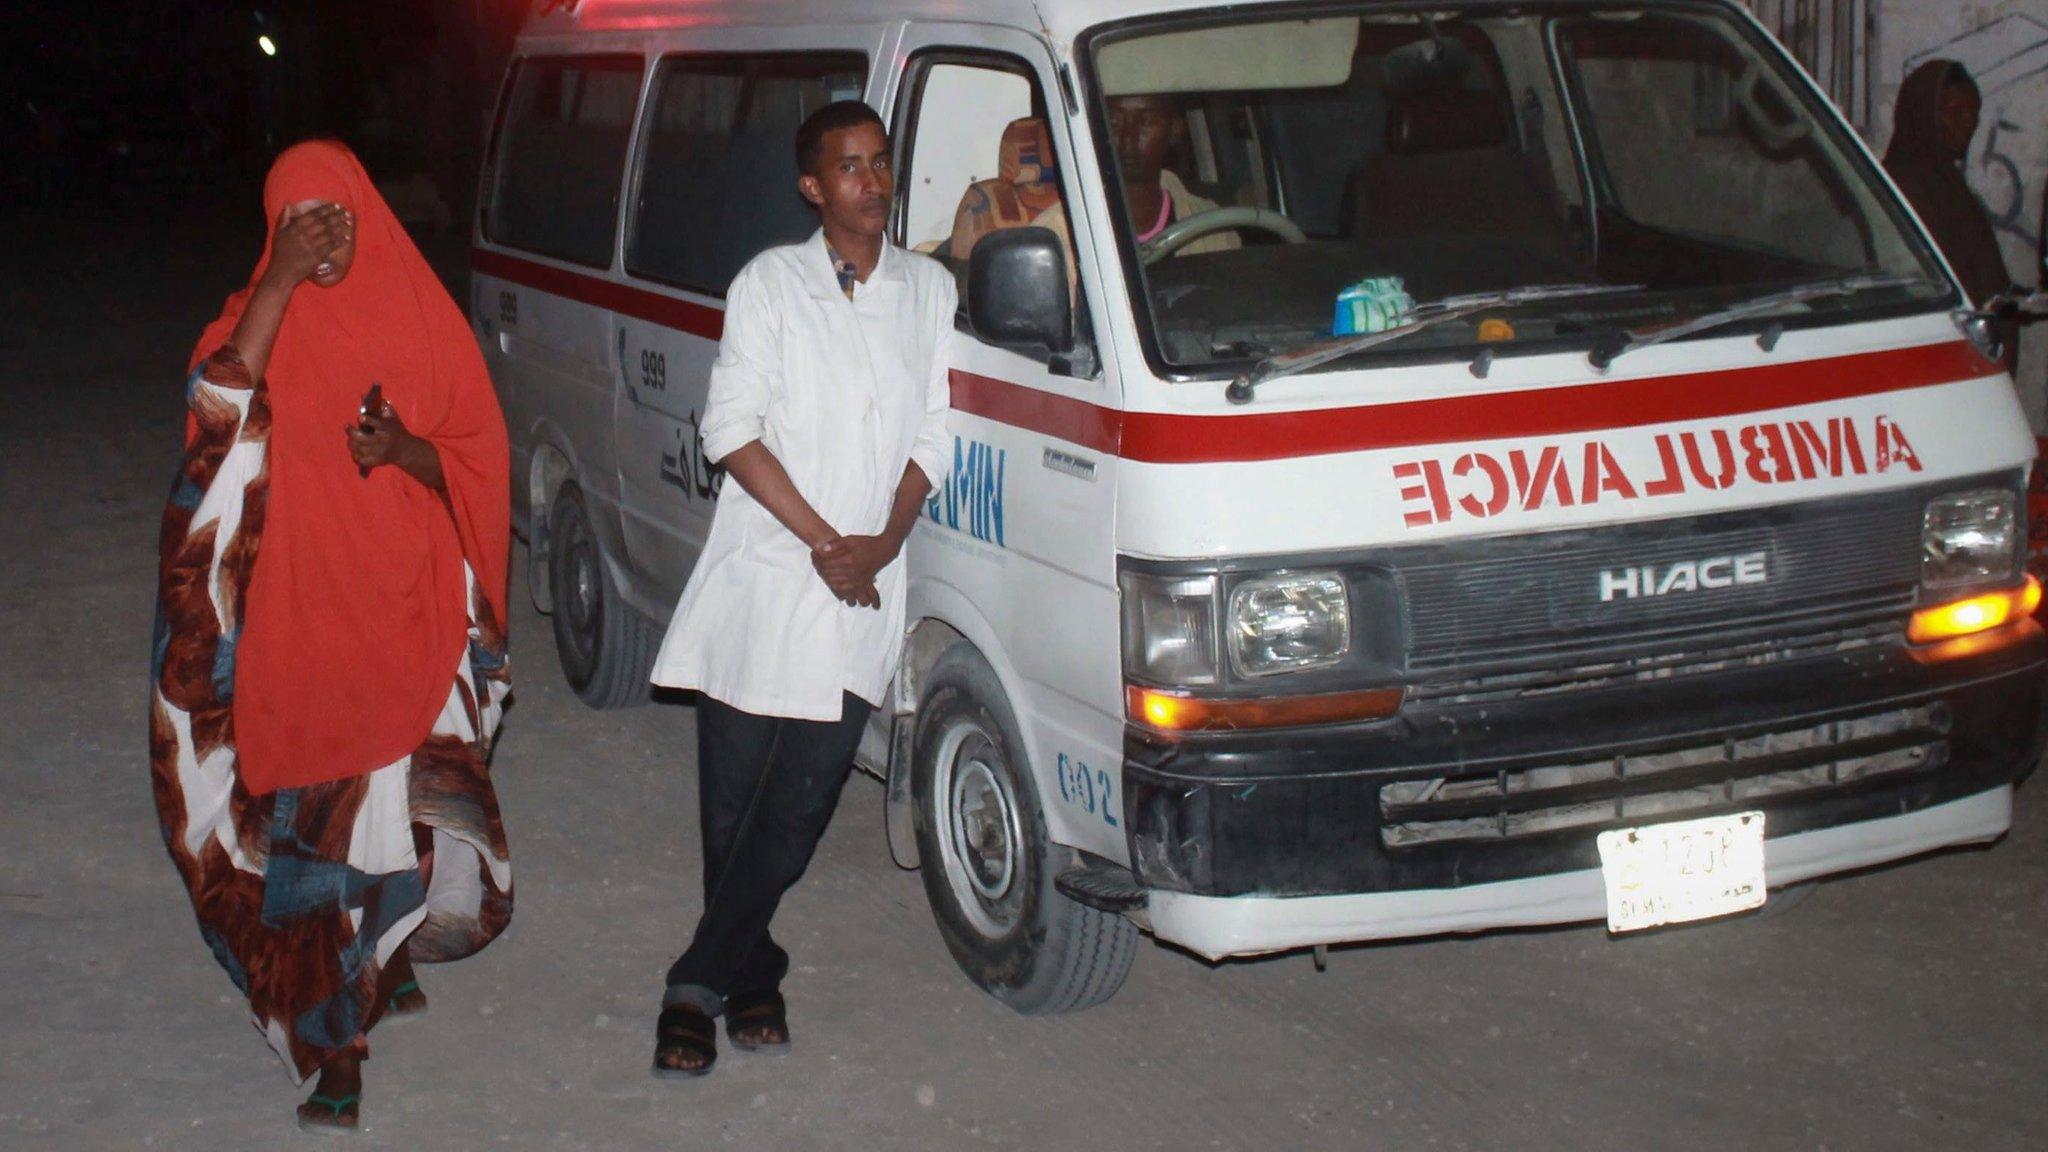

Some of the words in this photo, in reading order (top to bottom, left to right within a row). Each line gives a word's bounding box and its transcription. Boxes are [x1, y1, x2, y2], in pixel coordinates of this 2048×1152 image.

[641, 348, 666, 391] 999
[1599, 551, 1767, 601] HIACE
[1058, 752, 1118, 828] 002
